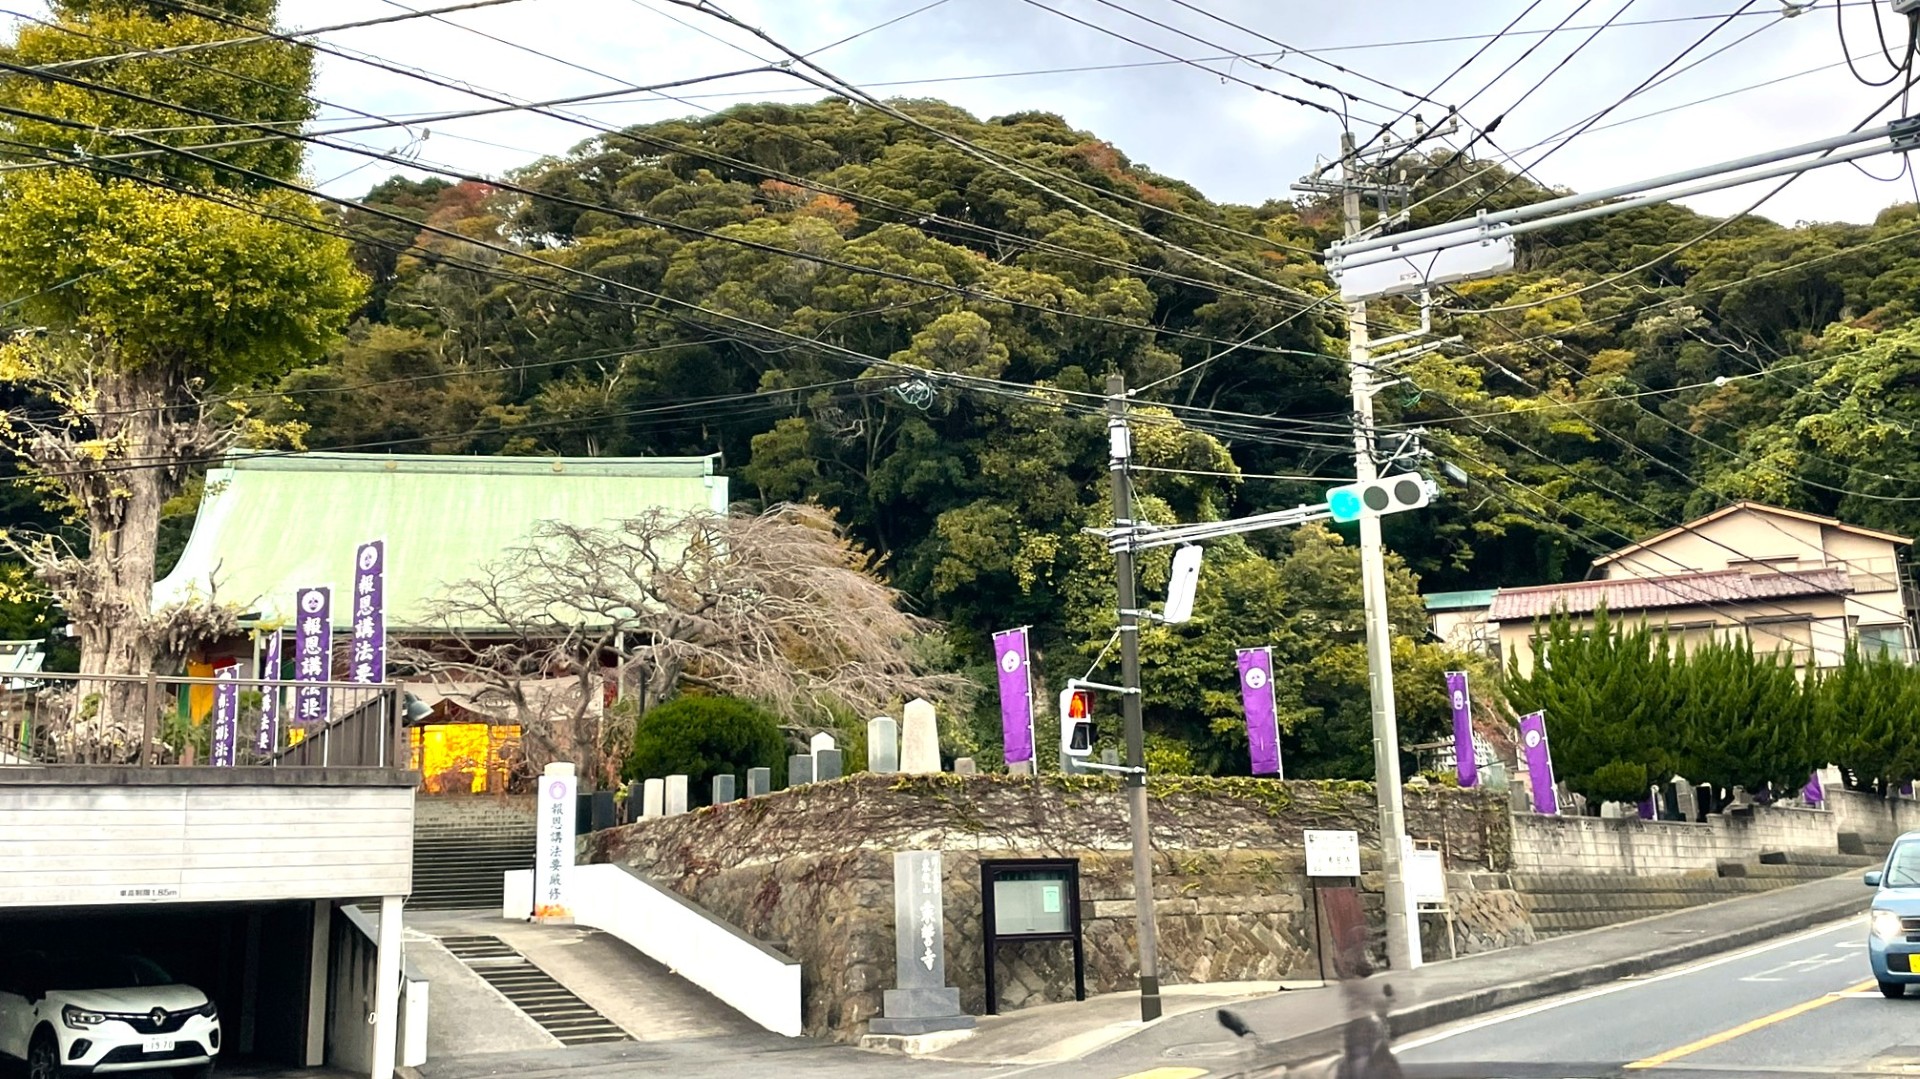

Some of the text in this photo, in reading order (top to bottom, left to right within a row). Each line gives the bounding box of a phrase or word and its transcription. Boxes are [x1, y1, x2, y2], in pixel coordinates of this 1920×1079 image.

[301, 617, 322, 718] 報恩講法要
[355, 574, 375, 684] 報恩講法要
